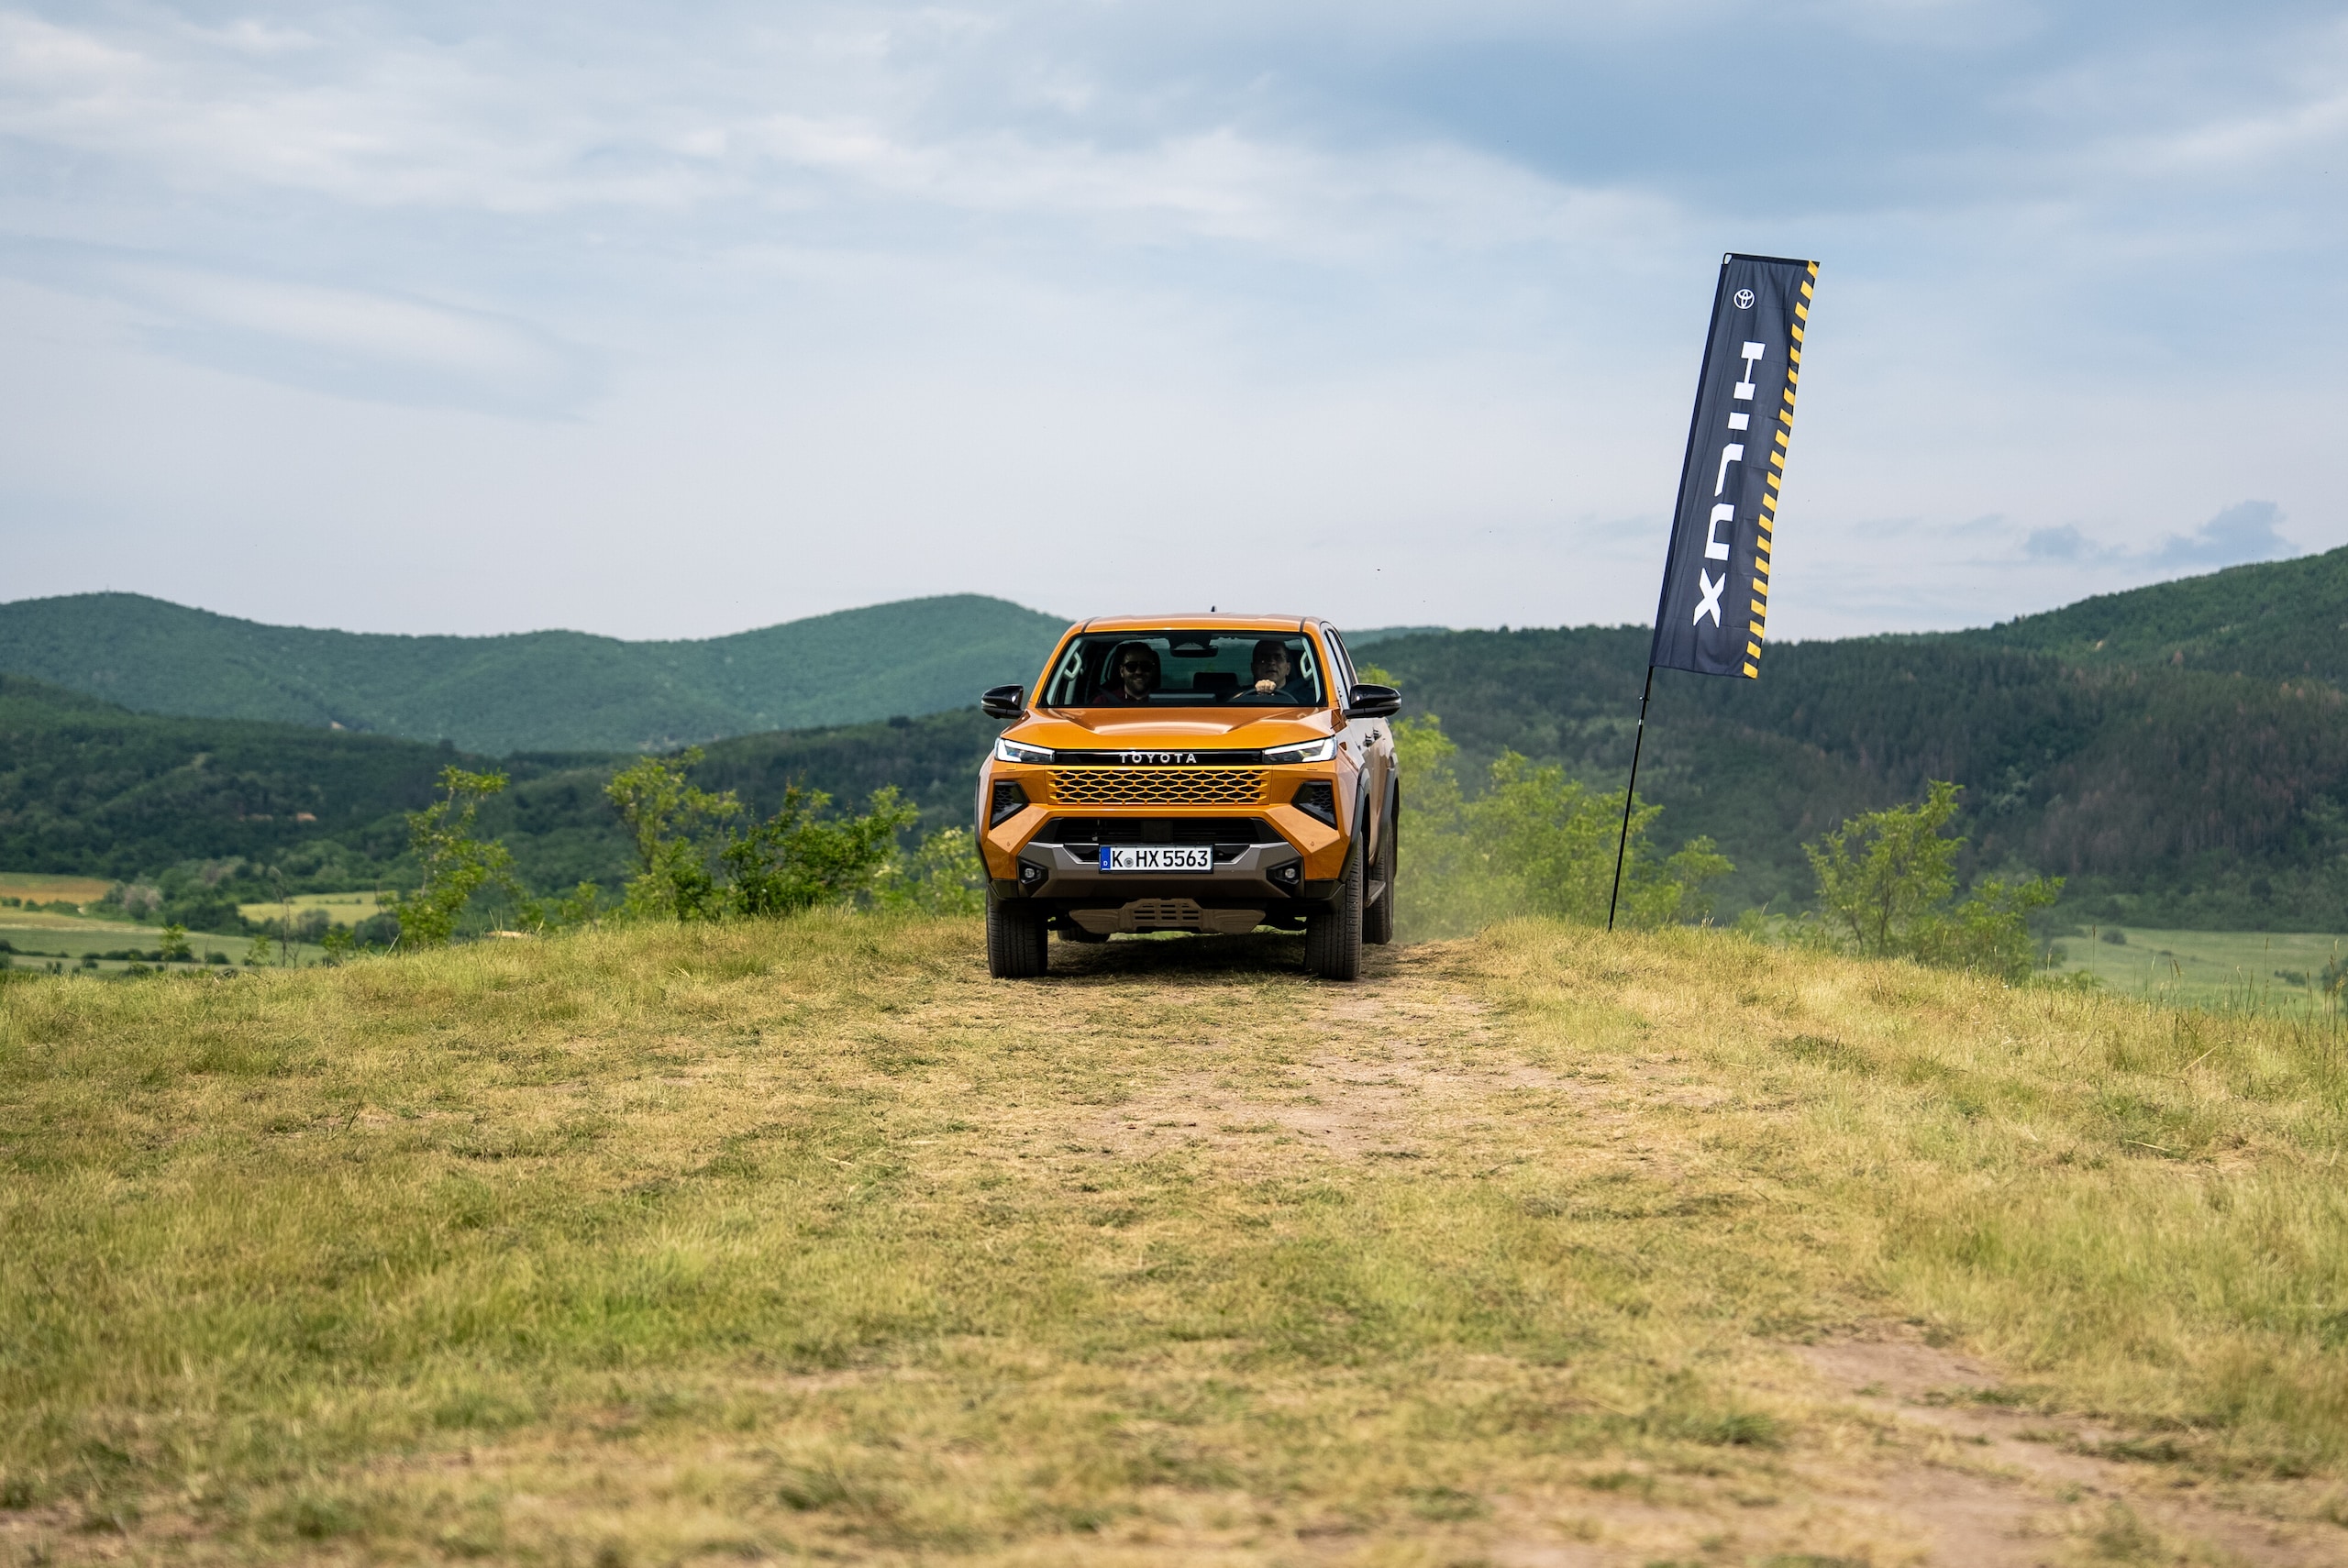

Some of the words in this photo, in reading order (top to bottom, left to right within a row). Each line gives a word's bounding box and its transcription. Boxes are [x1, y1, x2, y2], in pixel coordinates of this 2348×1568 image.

[1692, 341, 1767, 628] HILUX
[1119, 752, 1197, 764] TOYOTA
[1112, 850, 1124, 867] K
[1135, 850, 1159, 867] HX
[1163, 850, 1208, 867] 5563
